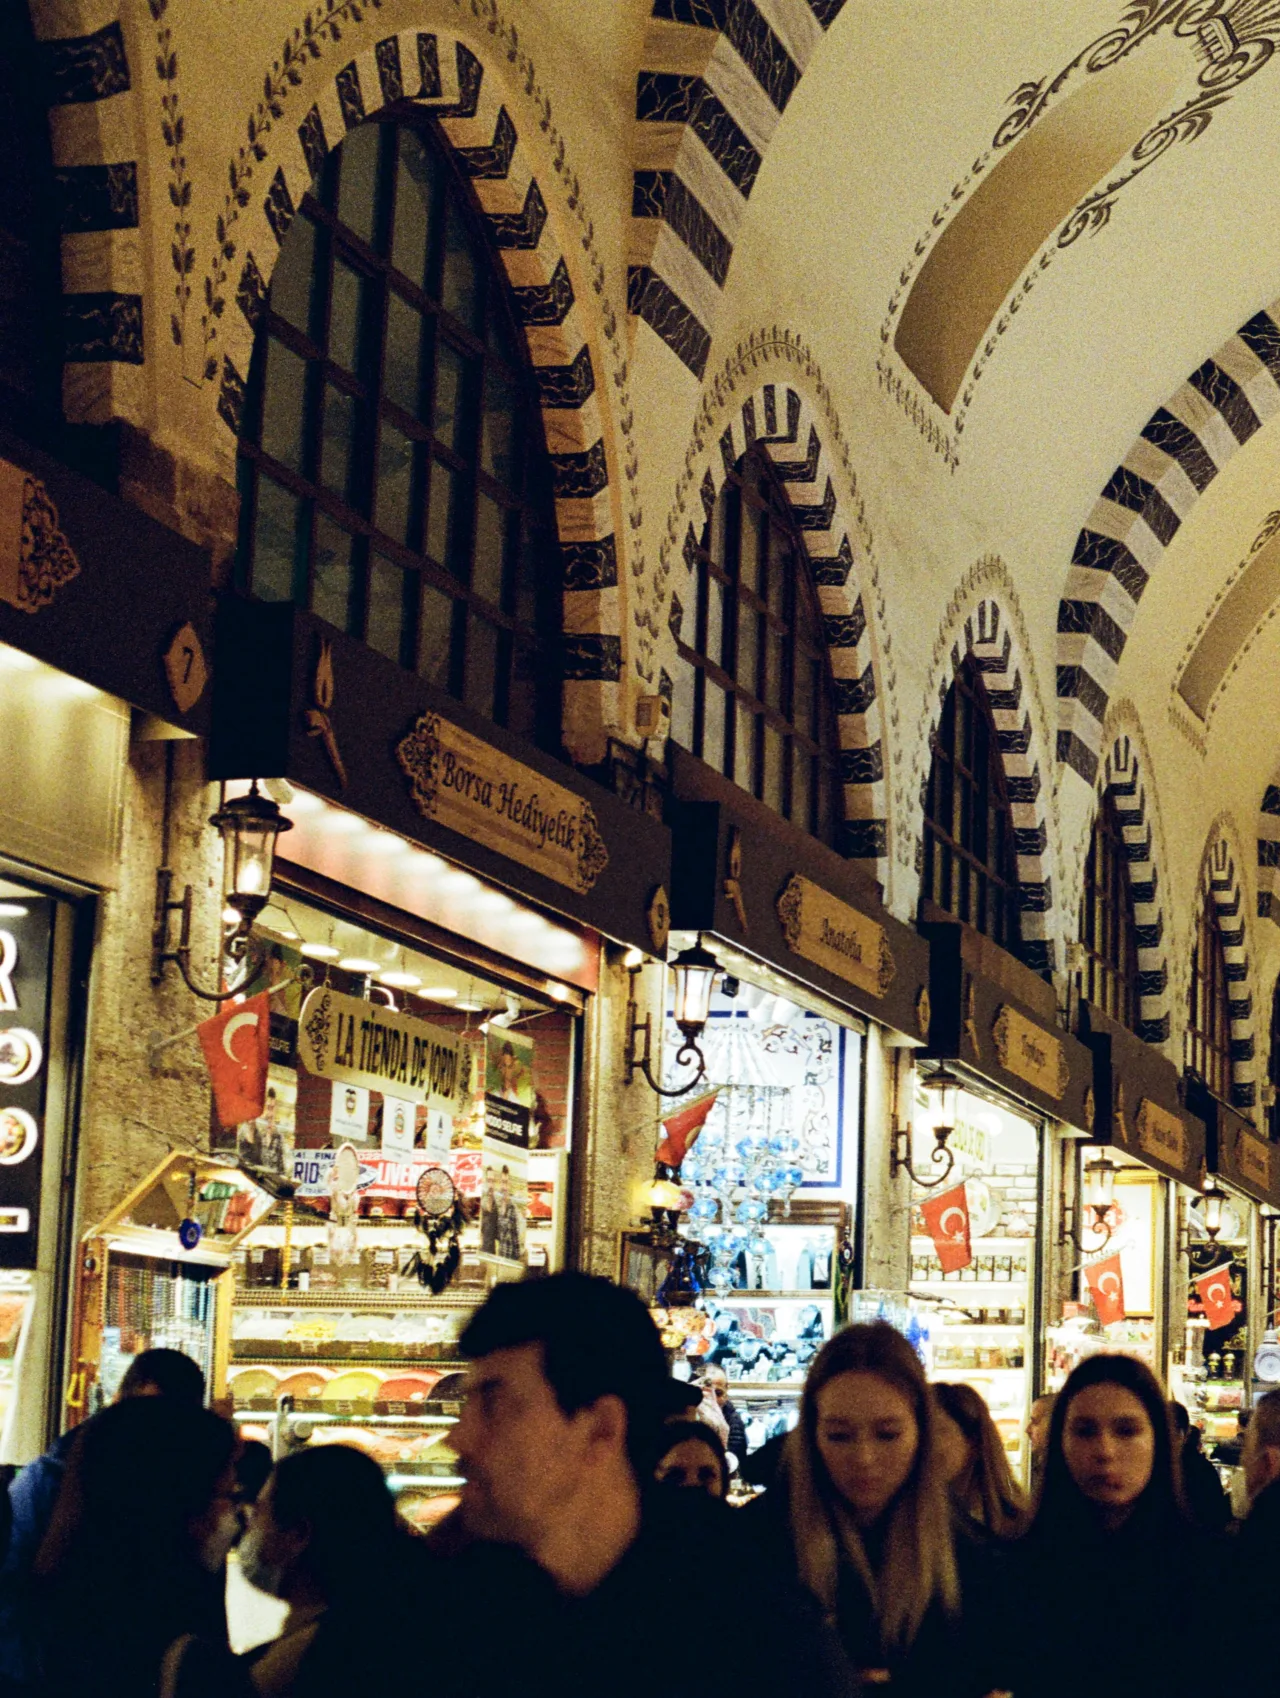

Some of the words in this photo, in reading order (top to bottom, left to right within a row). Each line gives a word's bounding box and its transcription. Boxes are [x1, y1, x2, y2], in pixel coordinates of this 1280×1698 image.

[182, 646, 195, 685] 7
[442, 751, 493, 809] Borsa
[496, 782, 577, 852] Hediyelik
[334, 1012, 355, 1069] LA
[409, 1035, 430, 1089] DE
